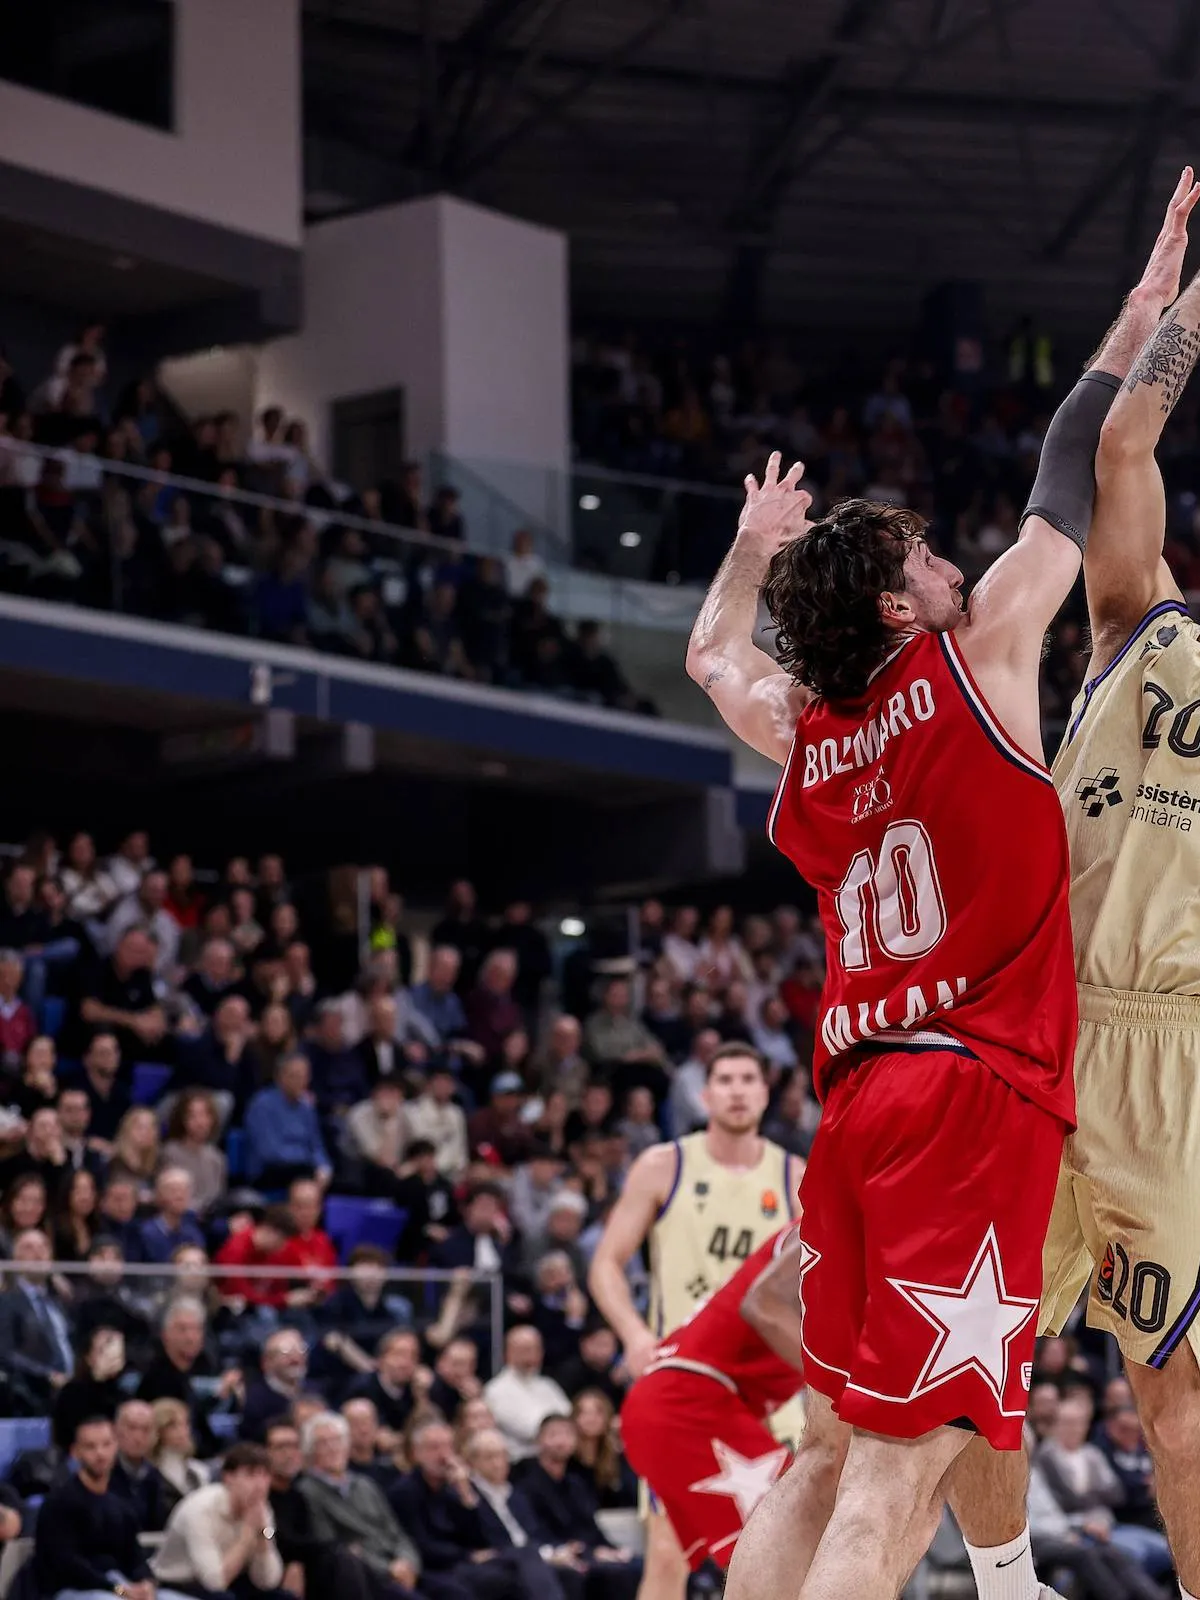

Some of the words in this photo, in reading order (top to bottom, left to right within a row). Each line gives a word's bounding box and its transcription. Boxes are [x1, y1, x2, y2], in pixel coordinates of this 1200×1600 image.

[802, 678, 937, 789] BOLMARO
[1128, 804, 1192, 832] anitària
[834, 818, 948, 973] 10
[708, 1225, 754, 1263] 44
[1111, 1242, 1172, 1334] 20
